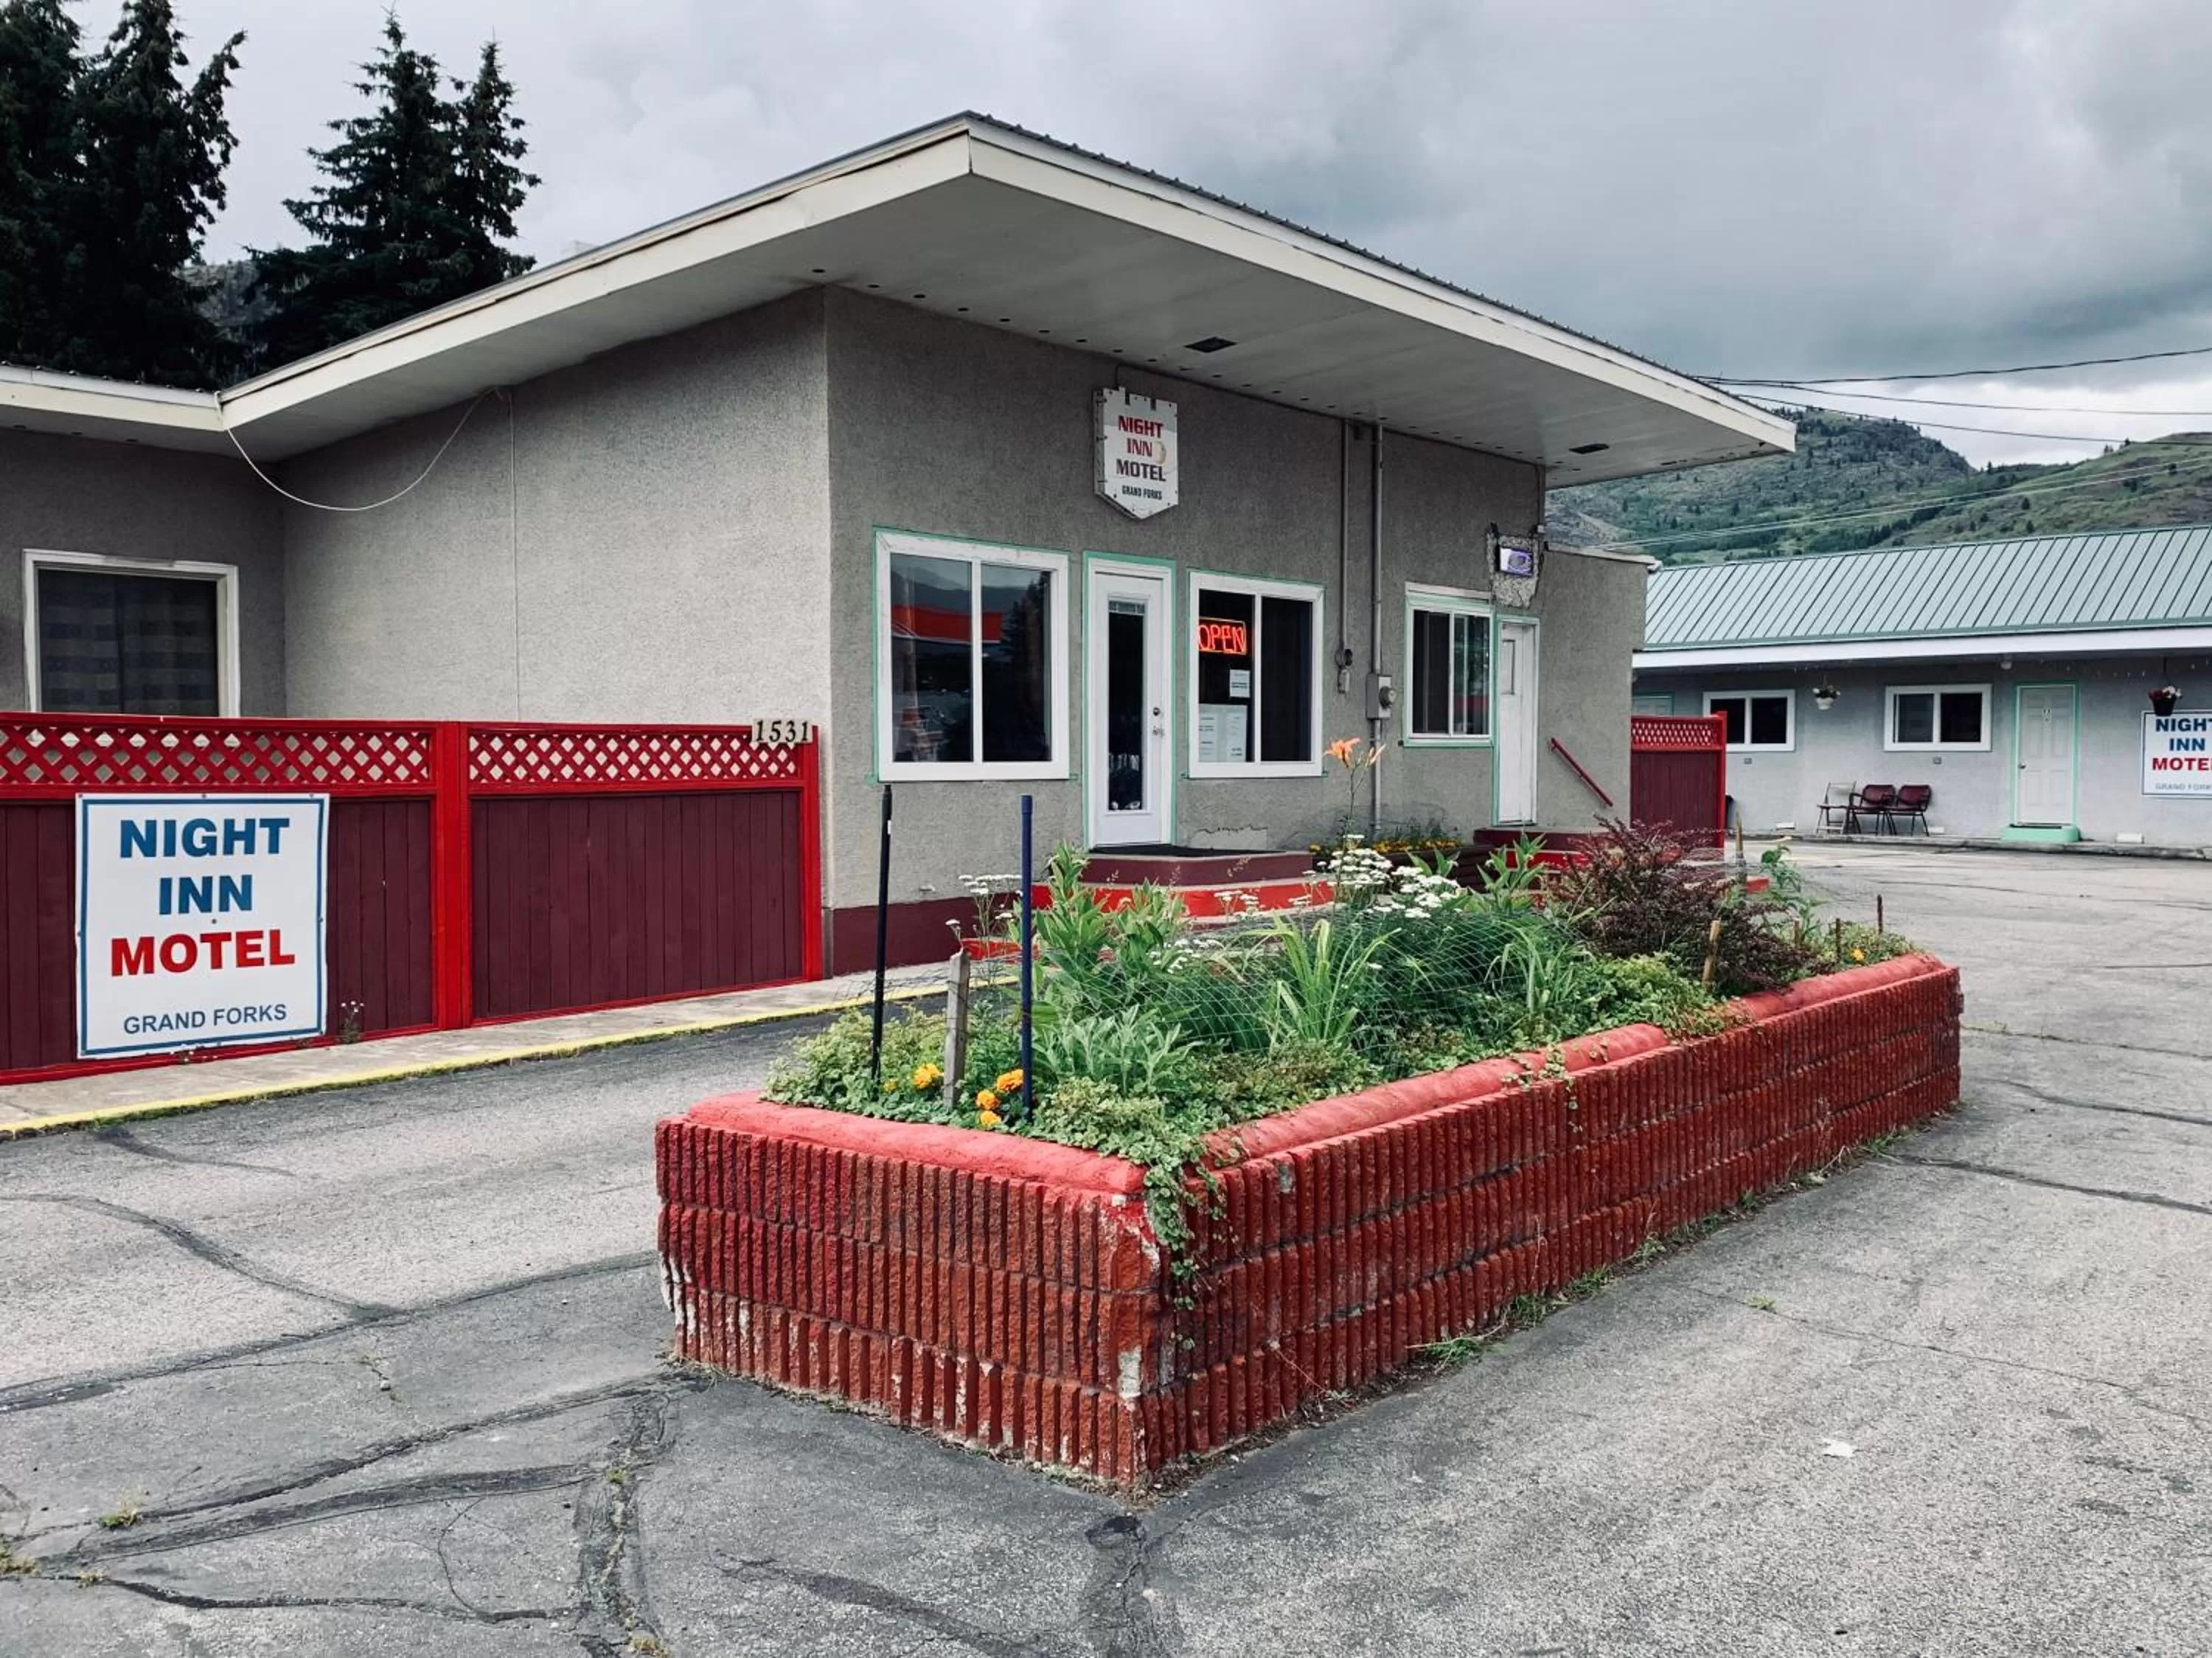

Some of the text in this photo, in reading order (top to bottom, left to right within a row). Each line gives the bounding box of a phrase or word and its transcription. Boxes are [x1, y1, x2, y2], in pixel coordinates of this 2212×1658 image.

[1118, 415, 1164, 439] NIGHT
[1127, 437, 1152, 457] INN
[1116, 458, 1166, 482] MOTEL
[1197, 623, 1245, 653] OPEN
[756, 719, 808, 742] 1531
[2169, 738, 2205, 752] INN
[2152, 757, 2212, 771] MOTE
[119, 817, 291, 858] NIGHT
[159, 874, 253, 915] INN
[111, 929, 296, 977] MOTEL
[123, 1004, 287, 1035] GRAND FORKS
